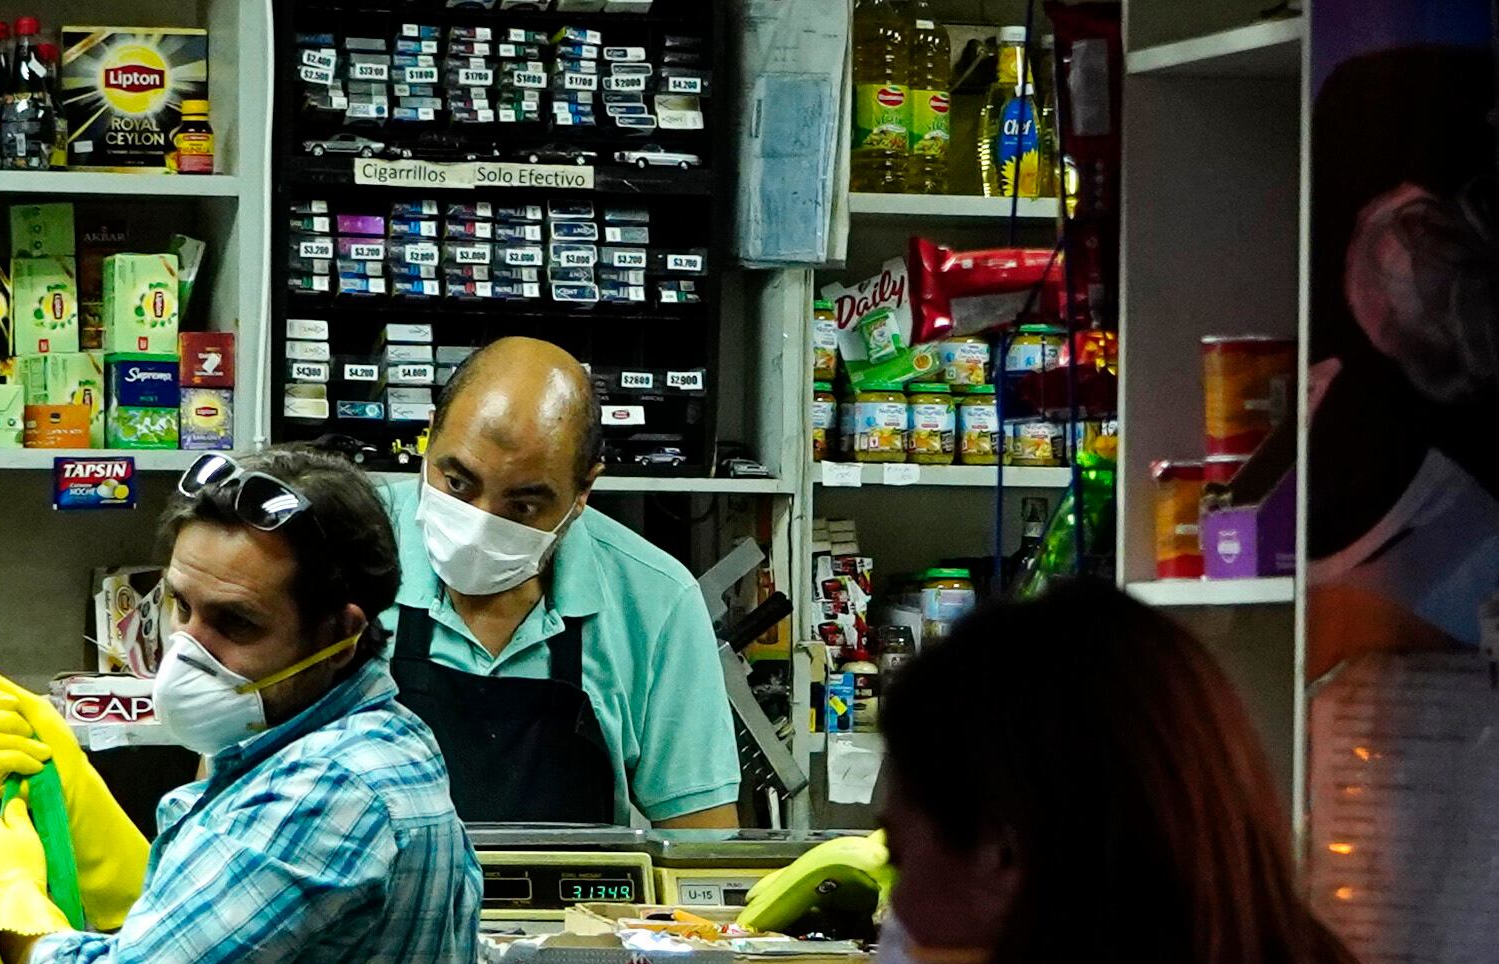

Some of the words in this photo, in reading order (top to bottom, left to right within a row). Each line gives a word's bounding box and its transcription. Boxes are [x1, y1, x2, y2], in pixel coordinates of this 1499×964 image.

[109, 70, 161, 88] Lipton
[465, 72, 489, 81] $1700
[568, 76, 593, 86] $1700
[110, 117, 161, 132] ROYAL
[105, 132, 165, 146] CEYLON
[362, 163, 447, 183] Cigarrillos
[477, 166, 513, 184] Solo
[518, 167, 586, 188] Efectivo
[54, 294, 63, 319] Lipton
[154, 293, 163, 318] Lipton
[835, 270, 905, 330] Daily
[63, 463, 128, 479] TAPSIN
[71, 696, 158, 722] CAP
[688, 890, 714, 900] U-15
